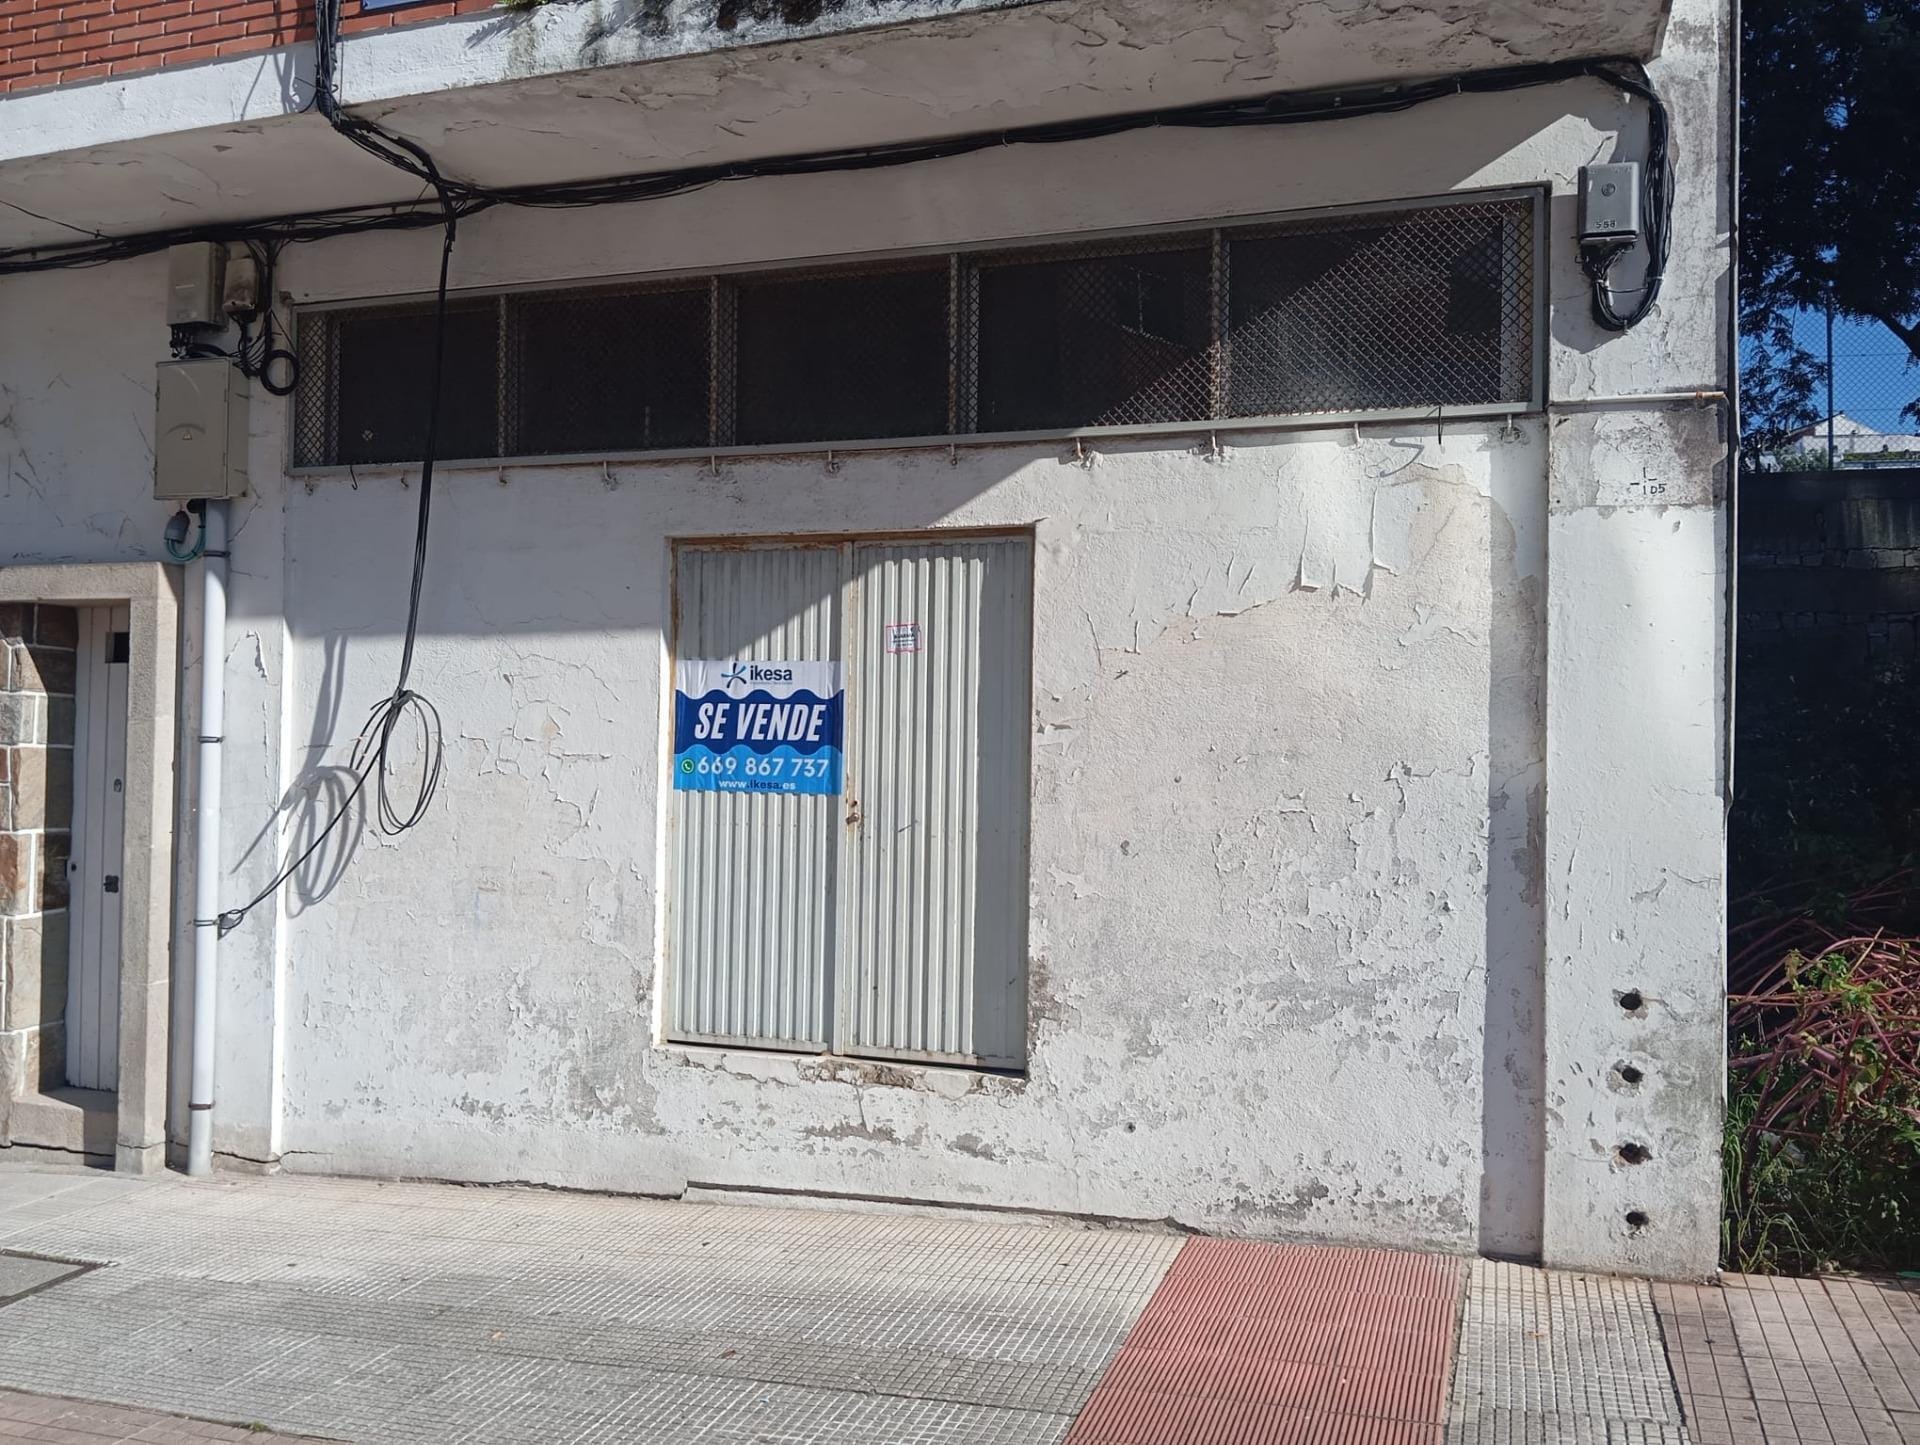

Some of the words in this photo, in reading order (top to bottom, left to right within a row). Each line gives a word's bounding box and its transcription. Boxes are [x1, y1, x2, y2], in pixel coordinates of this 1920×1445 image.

[750, 665, 793, 681] ikesa
[694, 702, 731, 740] SE
[736, 703, 827, 742] VENDE
[697, 756, 737, 775] 669
[745, 757, 785, 776] 867
[791, 758, 829, 778] 737
[718, 779, 796, 790] www.ikesa.es
